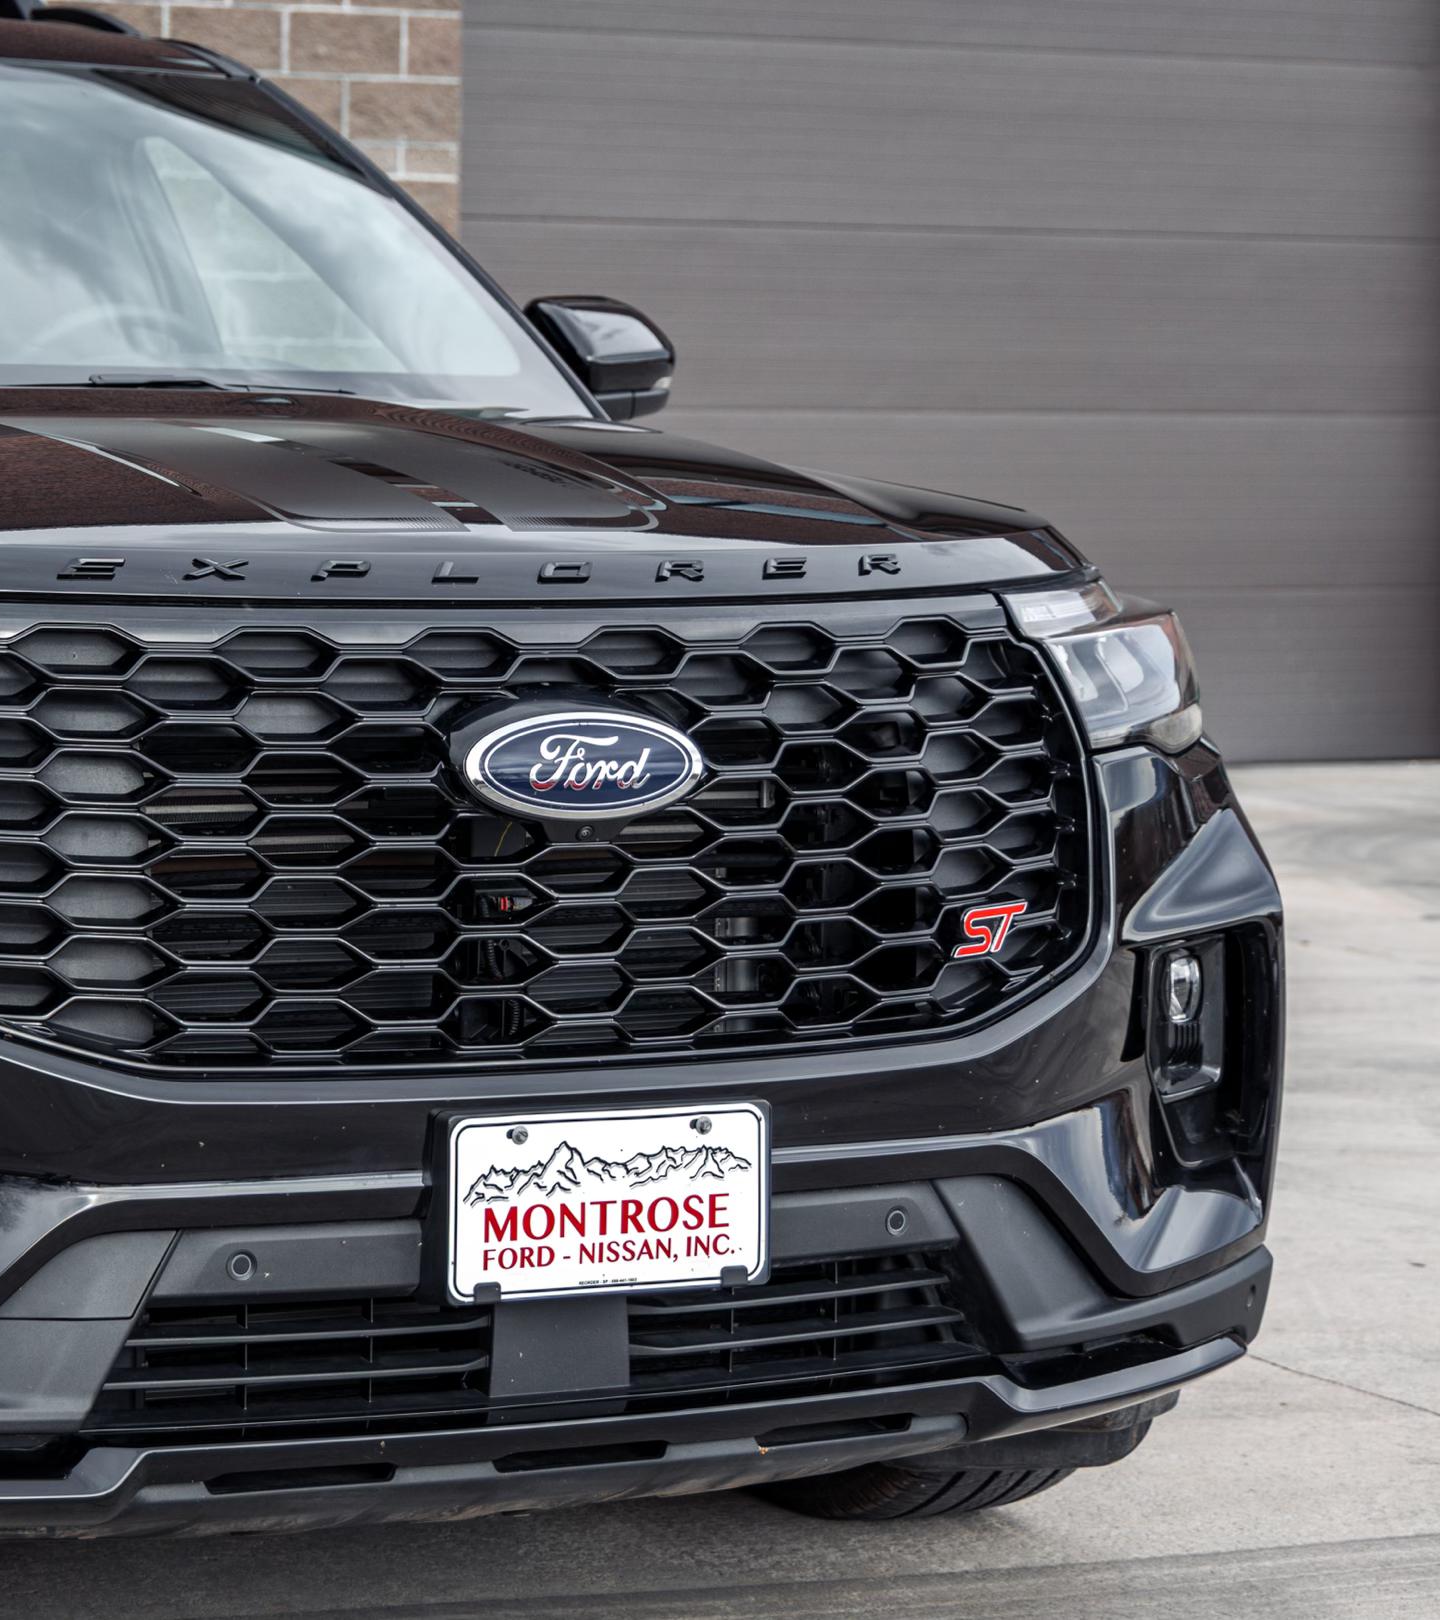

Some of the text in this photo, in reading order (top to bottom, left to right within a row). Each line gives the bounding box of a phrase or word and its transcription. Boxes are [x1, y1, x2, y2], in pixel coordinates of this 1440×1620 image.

[56, 554, 901, 585] EXPLORER
[529, 734, 651, 791] Ford
[952, 900, 1028, 958] ST
[484, 1193, 730, 1243] MONTROSE
[483, 1246, 555, 1271] FORD
[579, 1238, 679, 1265] NISSAN,
[686, 1234, 735, 1258] INC.
